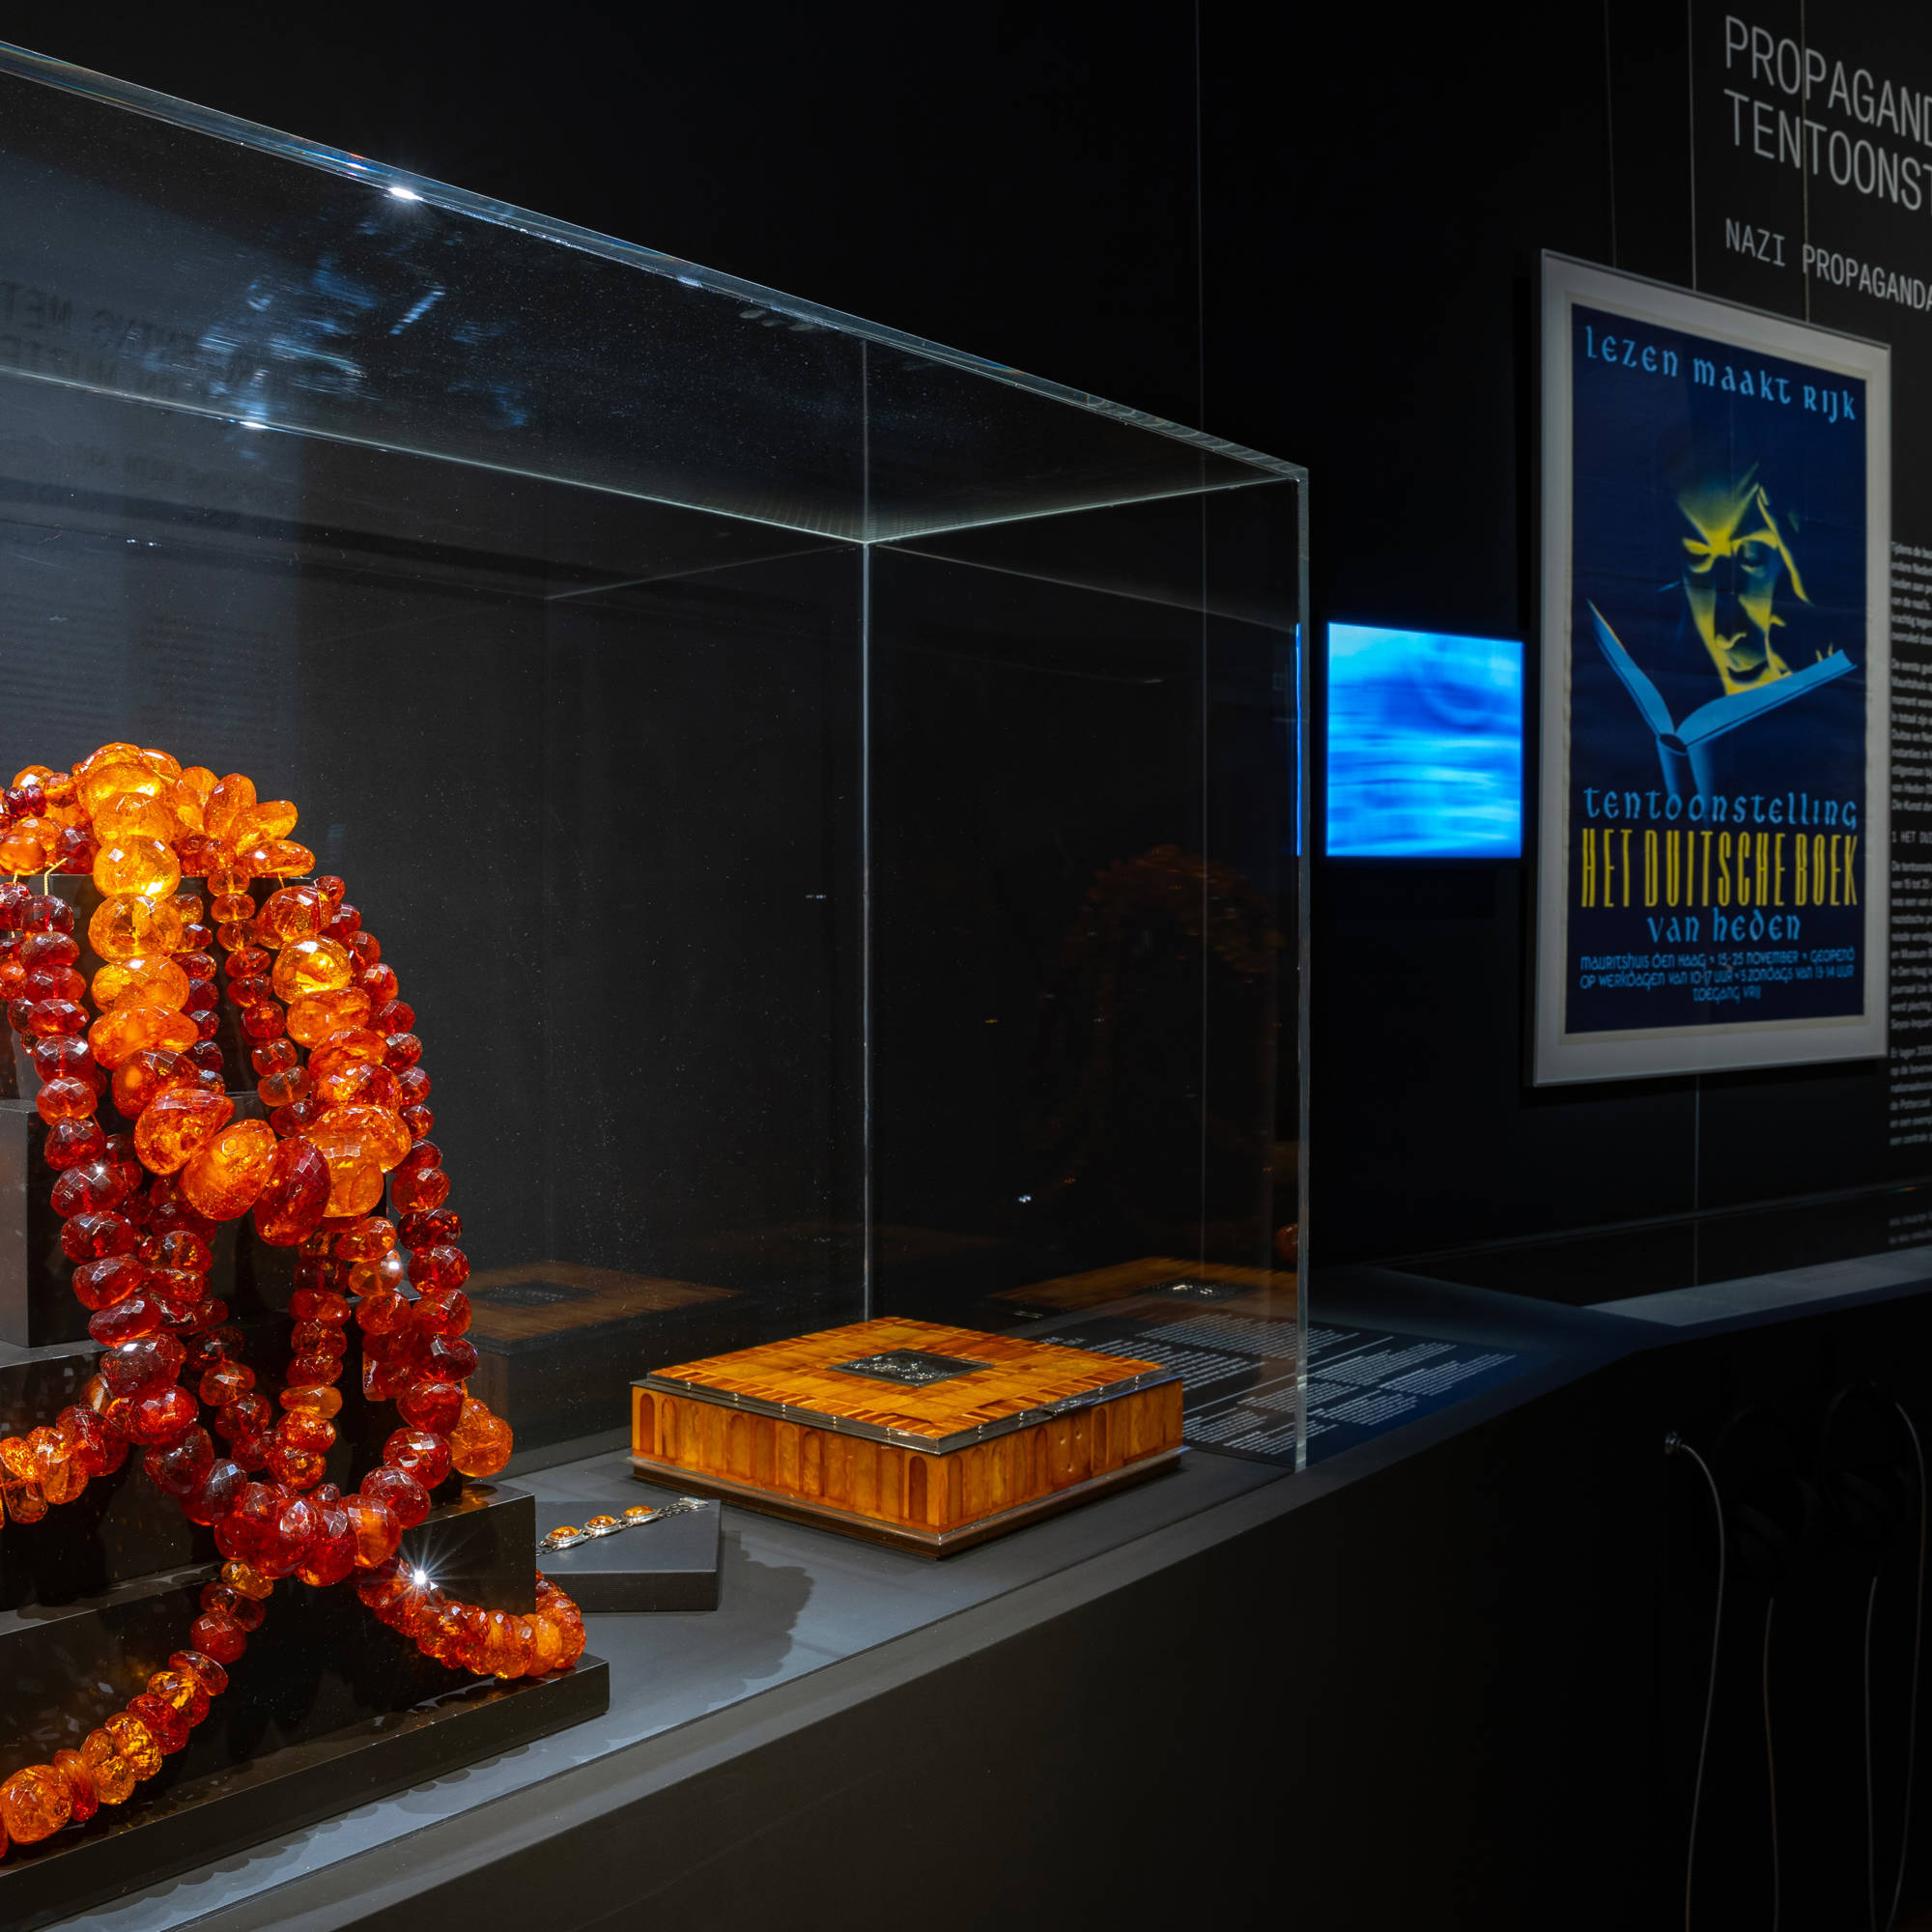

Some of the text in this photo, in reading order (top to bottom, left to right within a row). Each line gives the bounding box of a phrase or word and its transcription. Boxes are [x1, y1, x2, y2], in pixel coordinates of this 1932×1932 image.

[1725, 217, 1785, 267] NAZI
[1584, 786, 1857, 830] tentoonstelling
[1581, 828, 1858, 908] HET DUITSCHE BOEK
[1647, 906, 1801, 943] van heden
